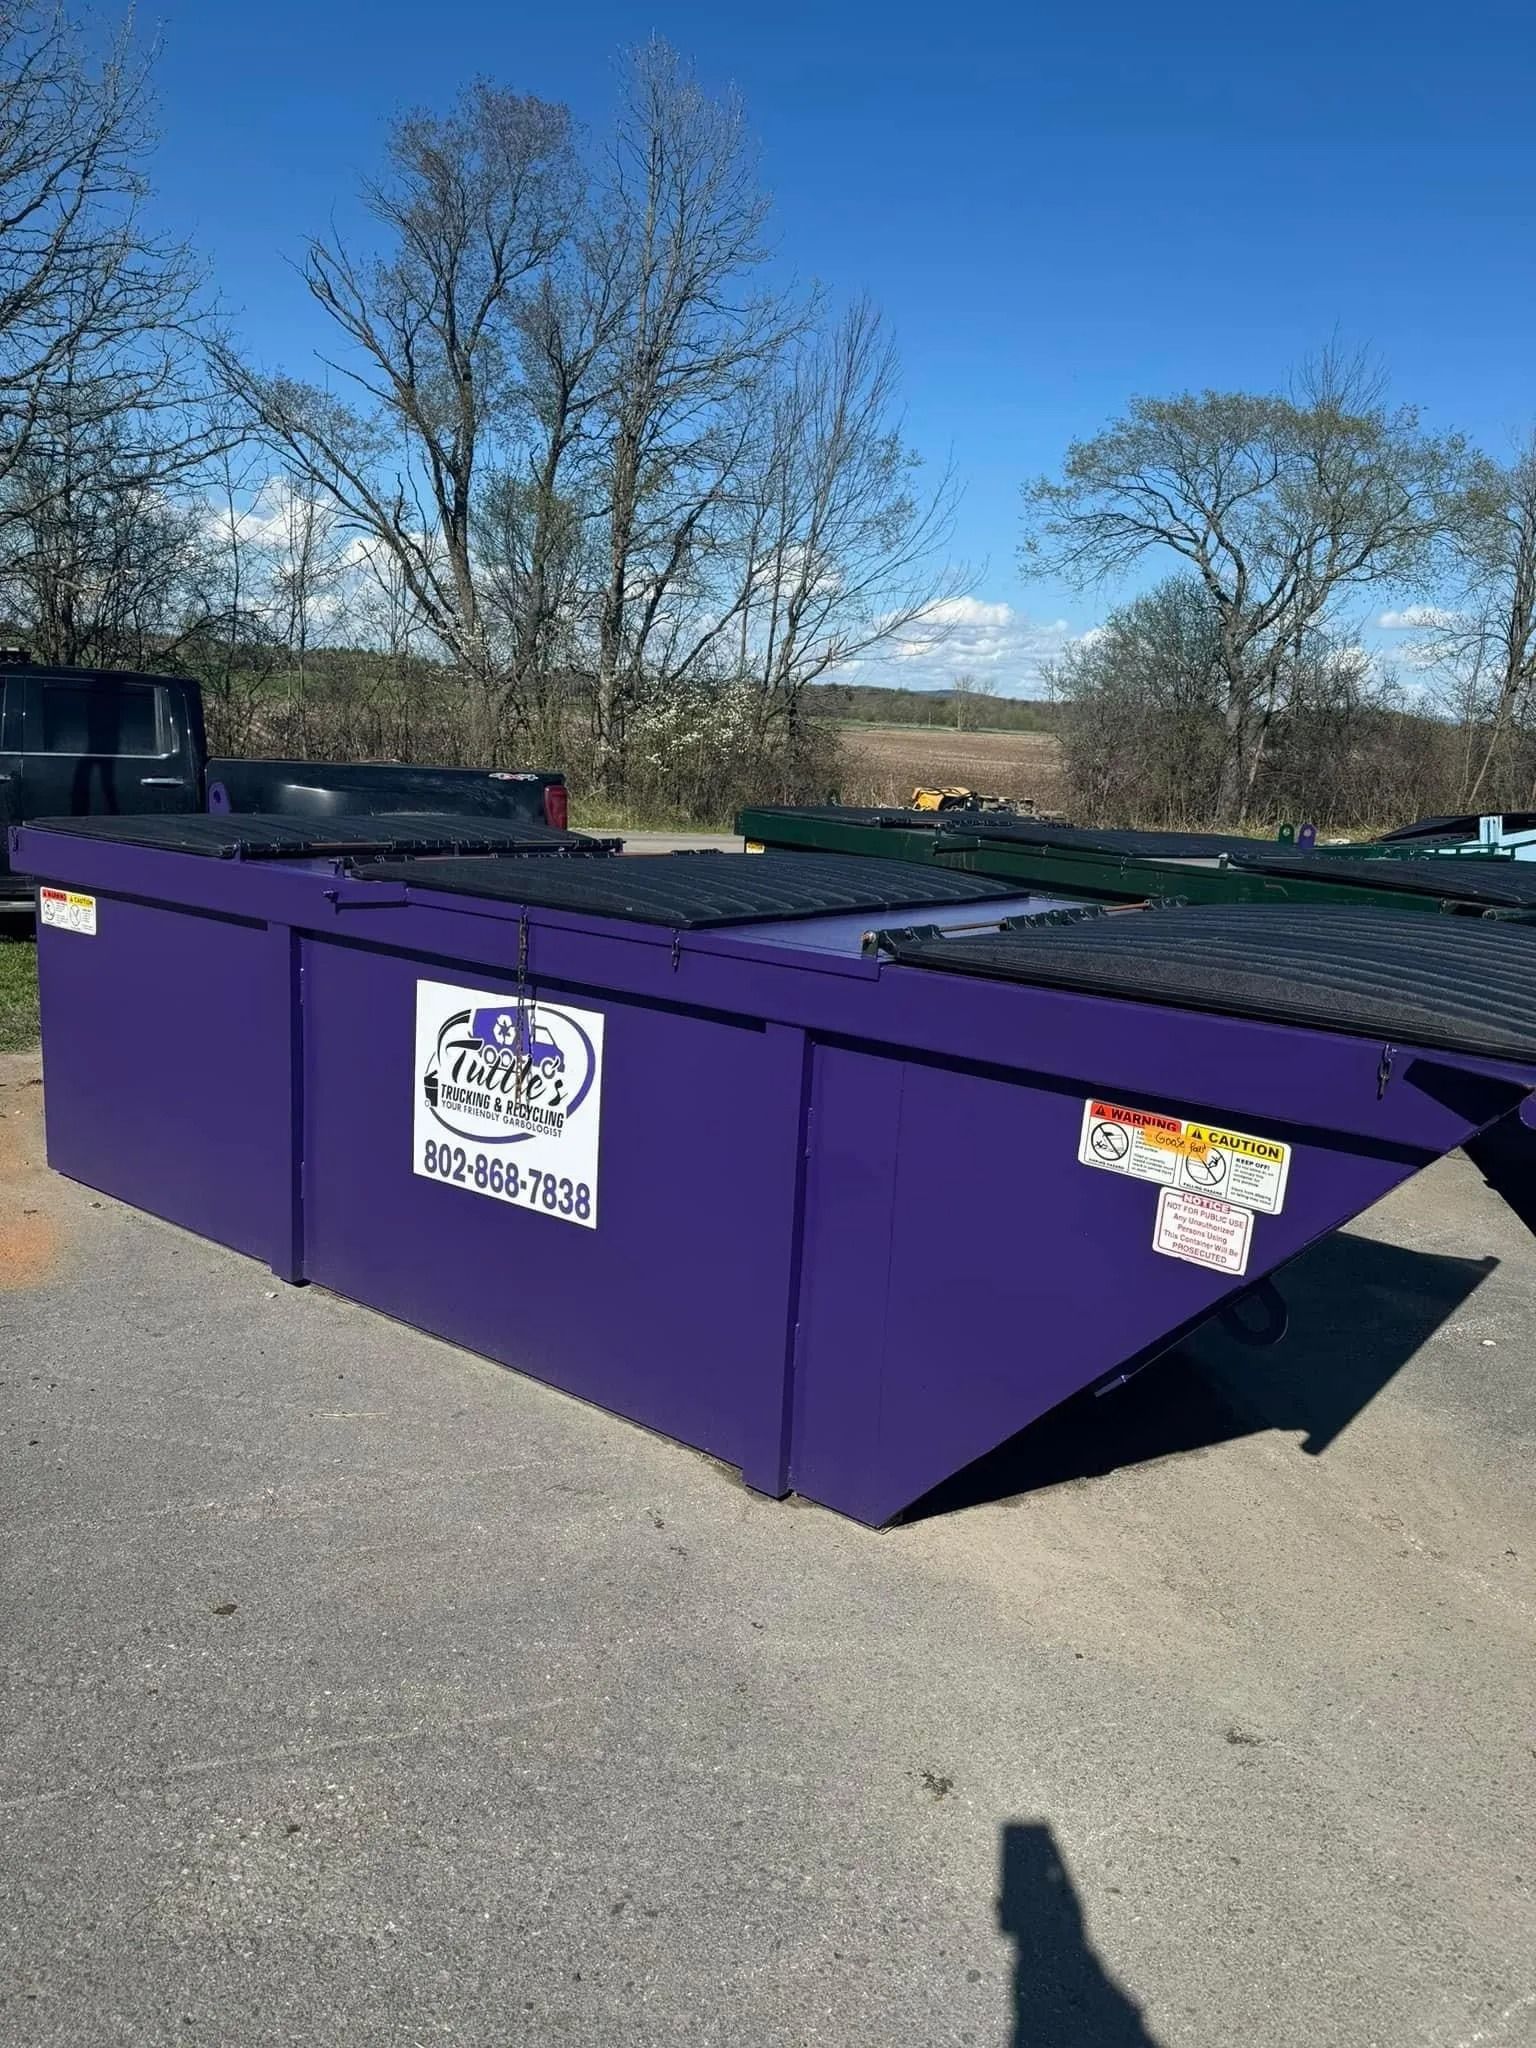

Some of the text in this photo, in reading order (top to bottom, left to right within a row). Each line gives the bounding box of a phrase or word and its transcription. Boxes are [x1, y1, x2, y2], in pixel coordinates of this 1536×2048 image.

[446, 1040, 568, 1107] Tuttle's
[440, 1084, 565, 1129] TRUCKING & RECYCLING
[441, 1100, 562, 1138] YOUR FRIENDLY GARBOLOGIST
[1111, 1108, 1177, 1132] WARNING
[1208, 1132, 1279, 1159] CAUTION
[1236, 1158, 1254, 1166] KEEP
[424, 1139, 591, 1221] 802-868-7838
[1167, 1201, 1244, 1229] NOT FOR PUBLIC USE
[1182, 1193, 1231, 1214] NOTICE
[1173, 1213, 1235, 1236] Any Unauthorized
[1177, 1223, 1228, 1245] Persons Using
[1164, 1229, 1239, 1257] This Container Will Be
[1172, 1241, 1227, 1264] PROSECUTED
